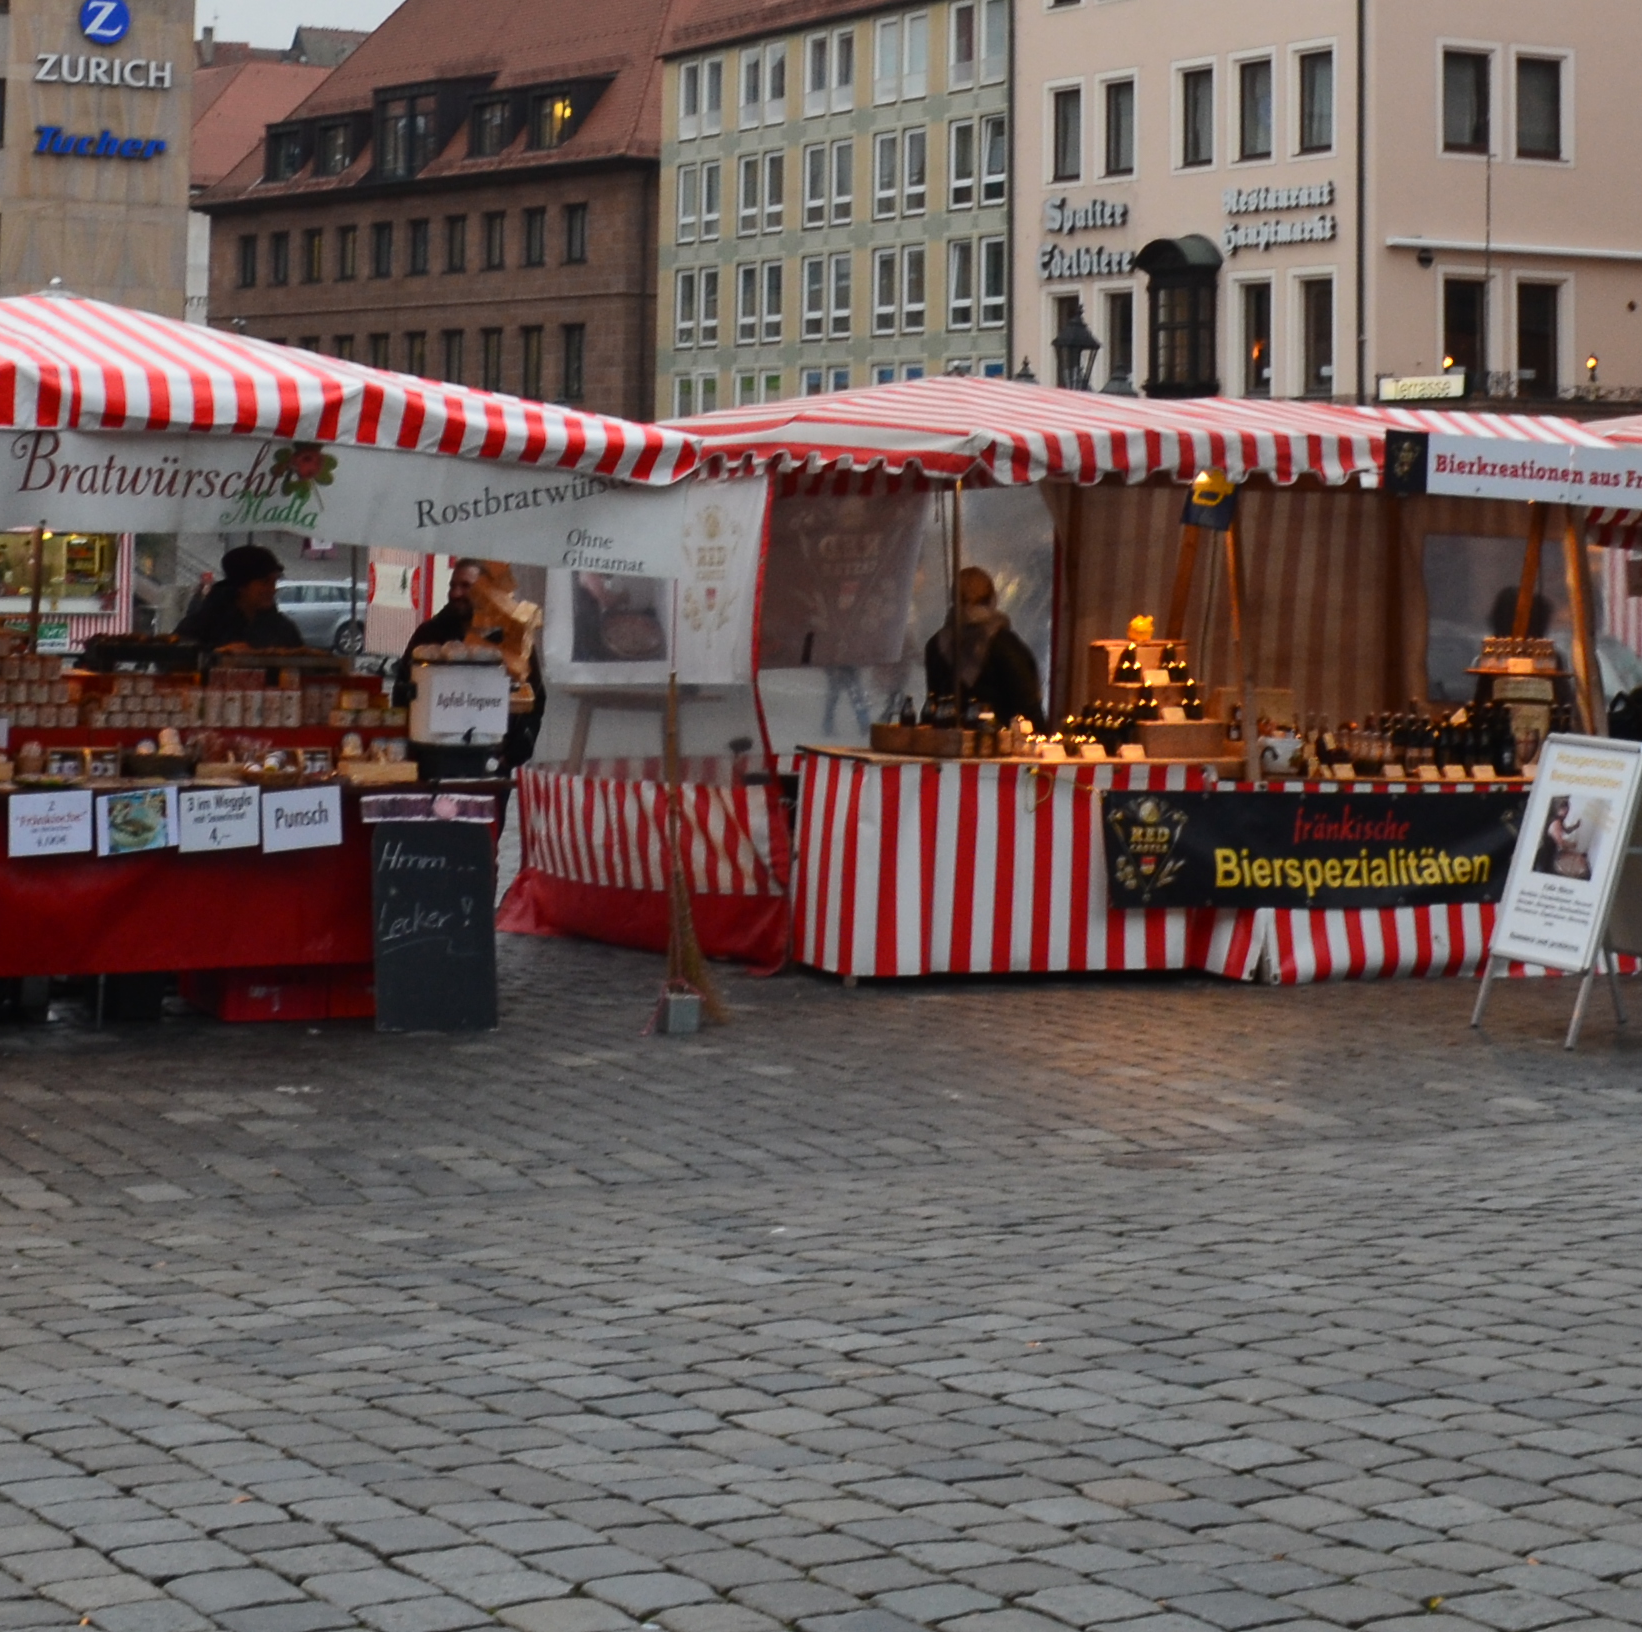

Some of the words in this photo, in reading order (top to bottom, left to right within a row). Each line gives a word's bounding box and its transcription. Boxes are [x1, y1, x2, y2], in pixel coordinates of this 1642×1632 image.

[83, 0, 123, 38] Z
[35, 53, 173, 88] ZURICH
[34, 125, 168, 160] Tucher
[1044, 195, 1130, 235] Spalter
[1221, 180, 1336, 215] Restaurant
[1222, 215, 1338, 256] Hauptmarkt
[1037, 243, 1137, 280] Edelbiere
[1391, 377, 1452, 400] Terrasse
[1433, 453, 1585, 486] Bierkreationen
[1589, 470, 1621, 488] aus
[220, 489, 319, 530] Madla
[566, 527, 614, 551] Ohne
[562, 549, 646, 573] Glutamat
[273, 800, 330, 830] Punsch
[1292, 804, 1411, 846] fränkische
[1129, 825, 1171, 843] RED
[1213, 847, 1492, 898] Bierspezialitäten
